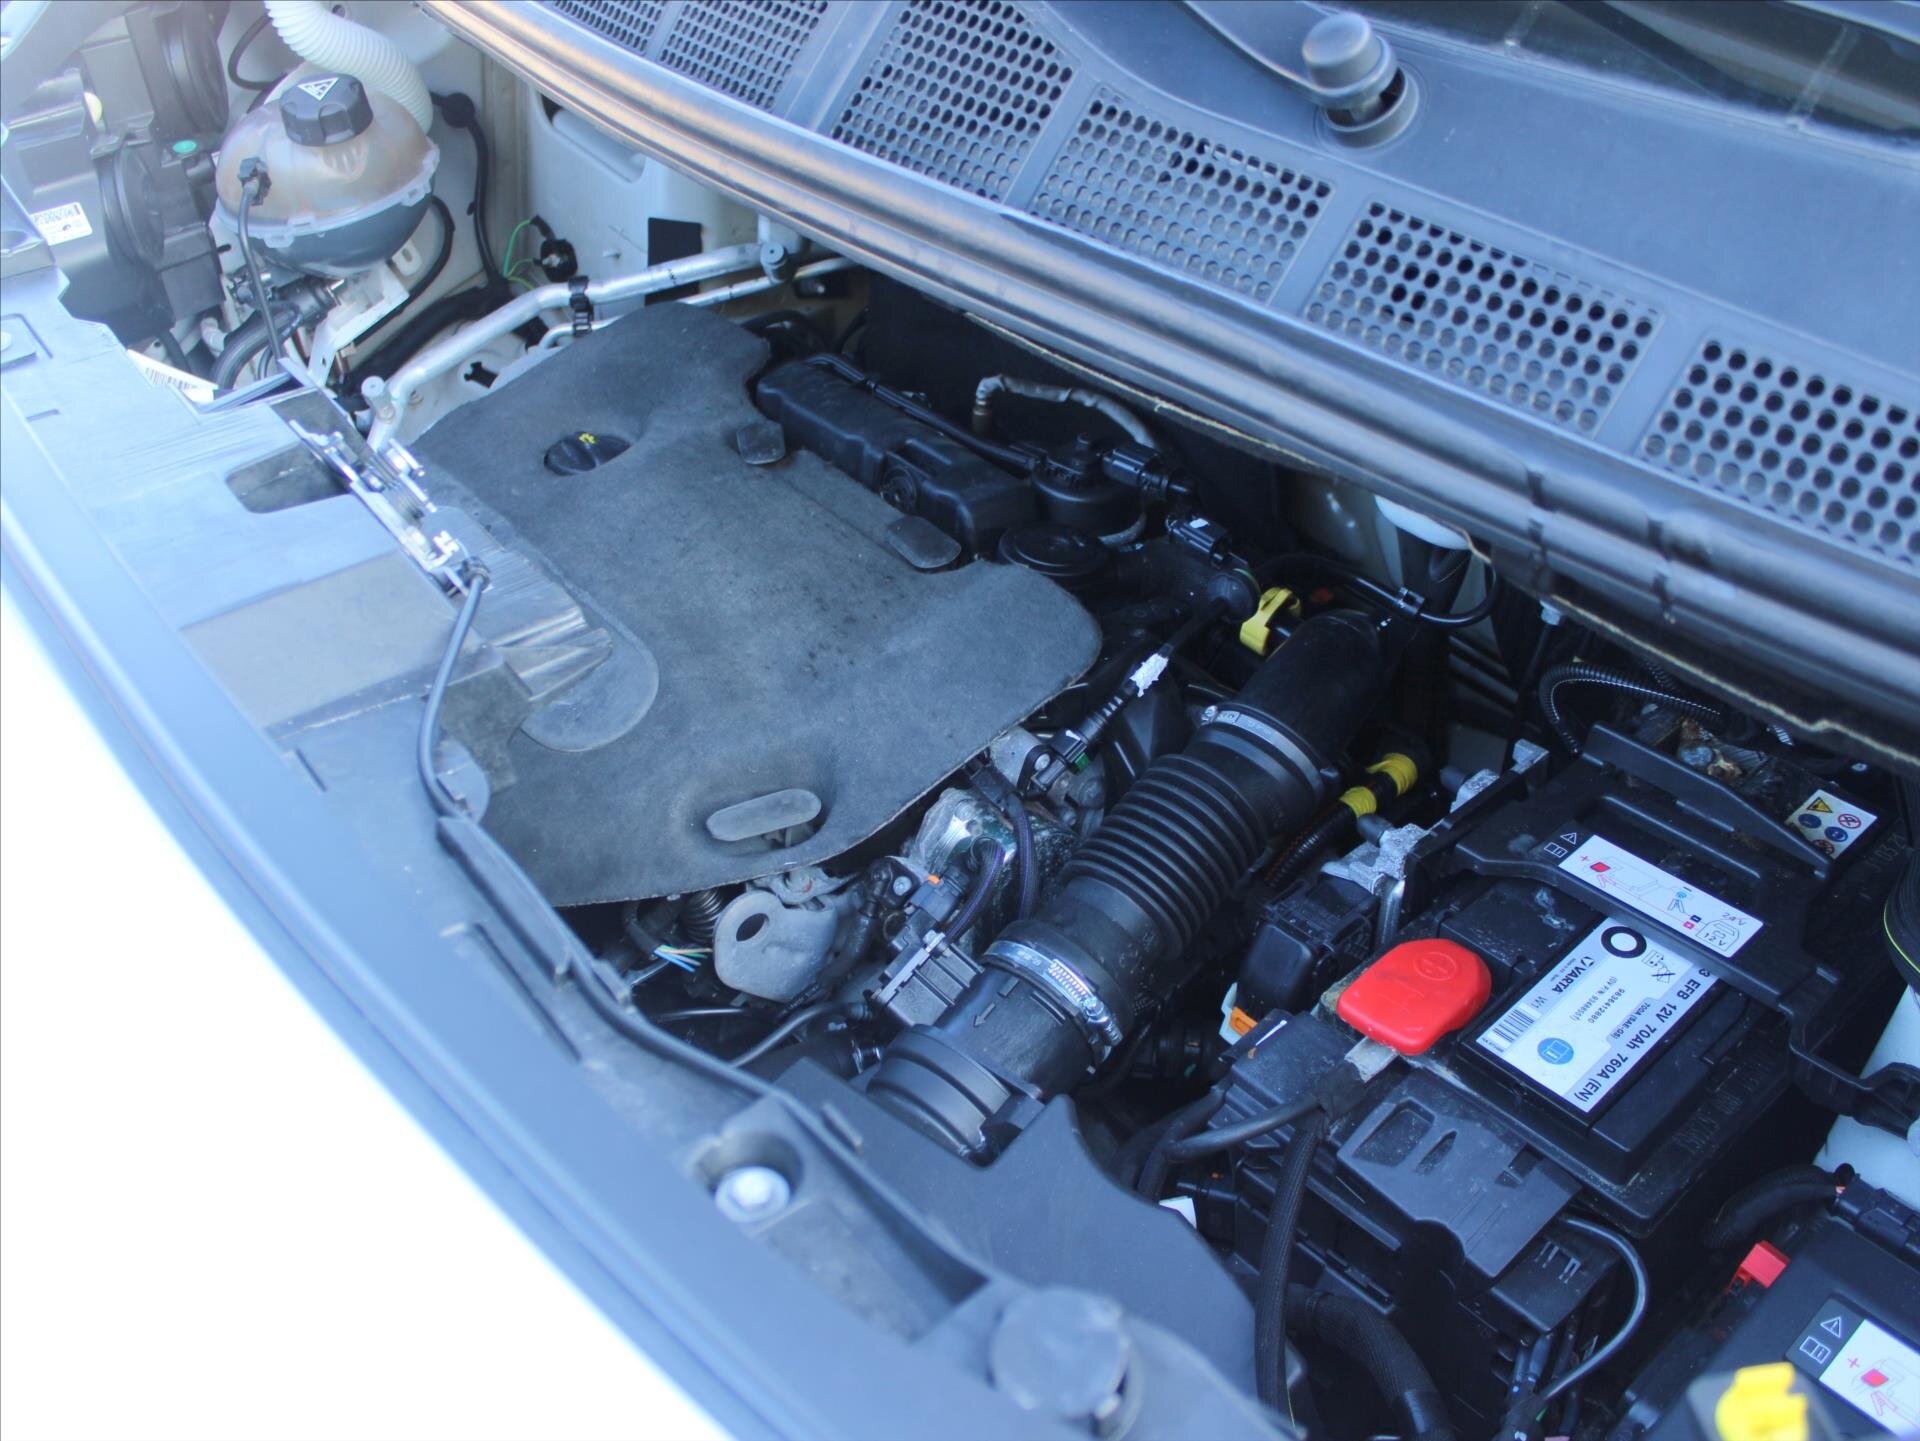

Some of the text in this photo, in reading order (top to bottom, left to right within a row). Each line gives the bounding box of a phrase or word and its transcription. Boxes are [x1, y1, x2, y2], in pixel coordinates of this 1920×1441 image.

[1552, 966, 1586, 993] VARTA
[1676, 979, 1701, 1000] EFB
[1634, 1002, 1651, 1016] 700A
[1655, 1003, 1677, 1023] 12V
[1626, 1024, 1657, 1050] 70Ah
[1597, 1053, 1628, 1079] 760A
[1574, 1078, 1602, 1102] (EN)
